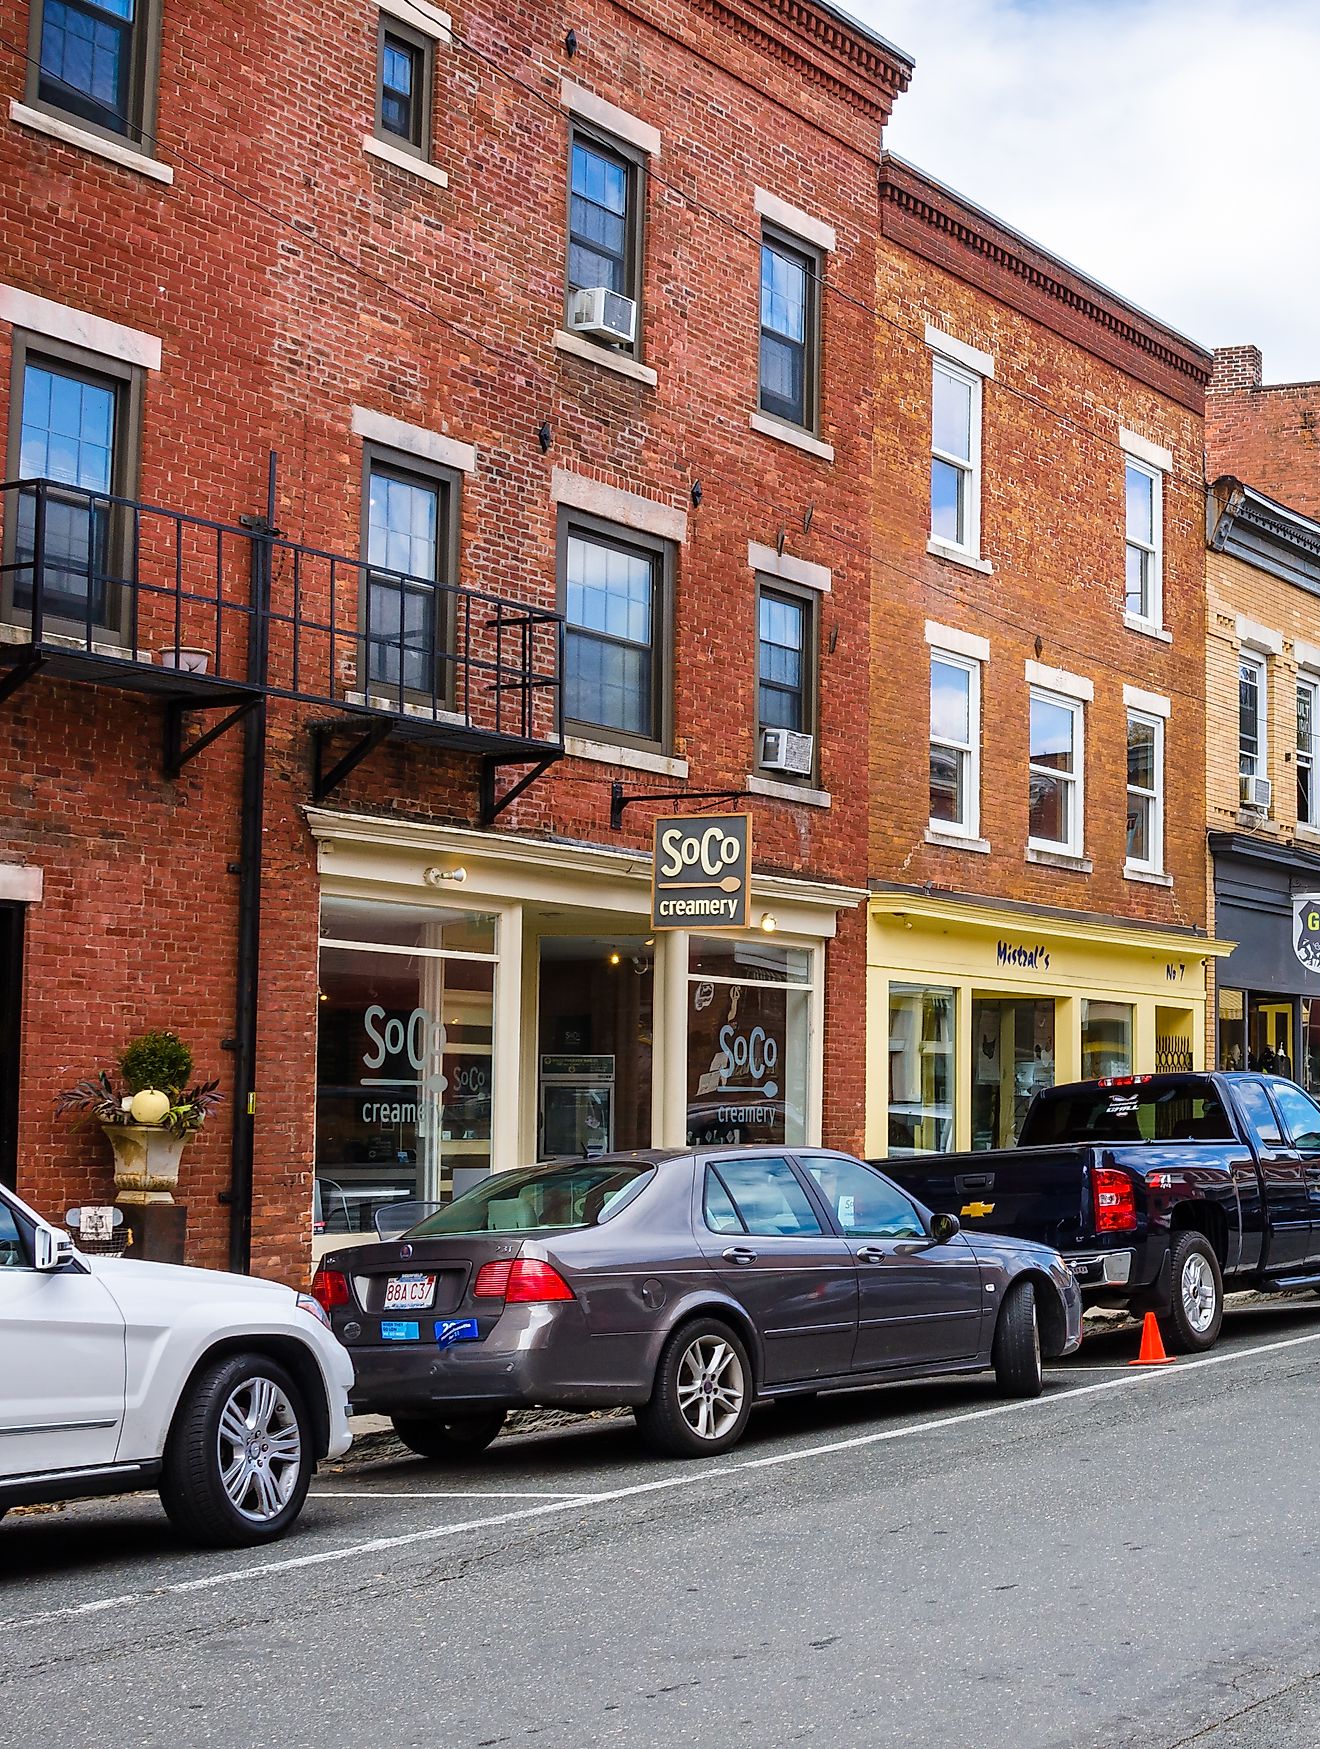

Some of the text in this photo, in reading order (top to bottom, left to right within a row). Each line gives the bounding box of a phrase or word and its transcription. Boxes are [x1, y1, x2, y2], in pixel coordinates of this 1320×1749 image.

[660, 827, 741, 877] SoCo
[659, 898, 739, 919] creamery
[996, 939, 1051, 970] Mistral's
[1178, 964, 1186, 981] 7
[362, 1004, 447, 1071] SoCo
[719, 1024, 778, 1079] SoCo
[453, 1066, 486, 1092] SoCo
[717, 1105, 777, 1128] creamery
[387, 1282, 433, 1301] 88A C37
